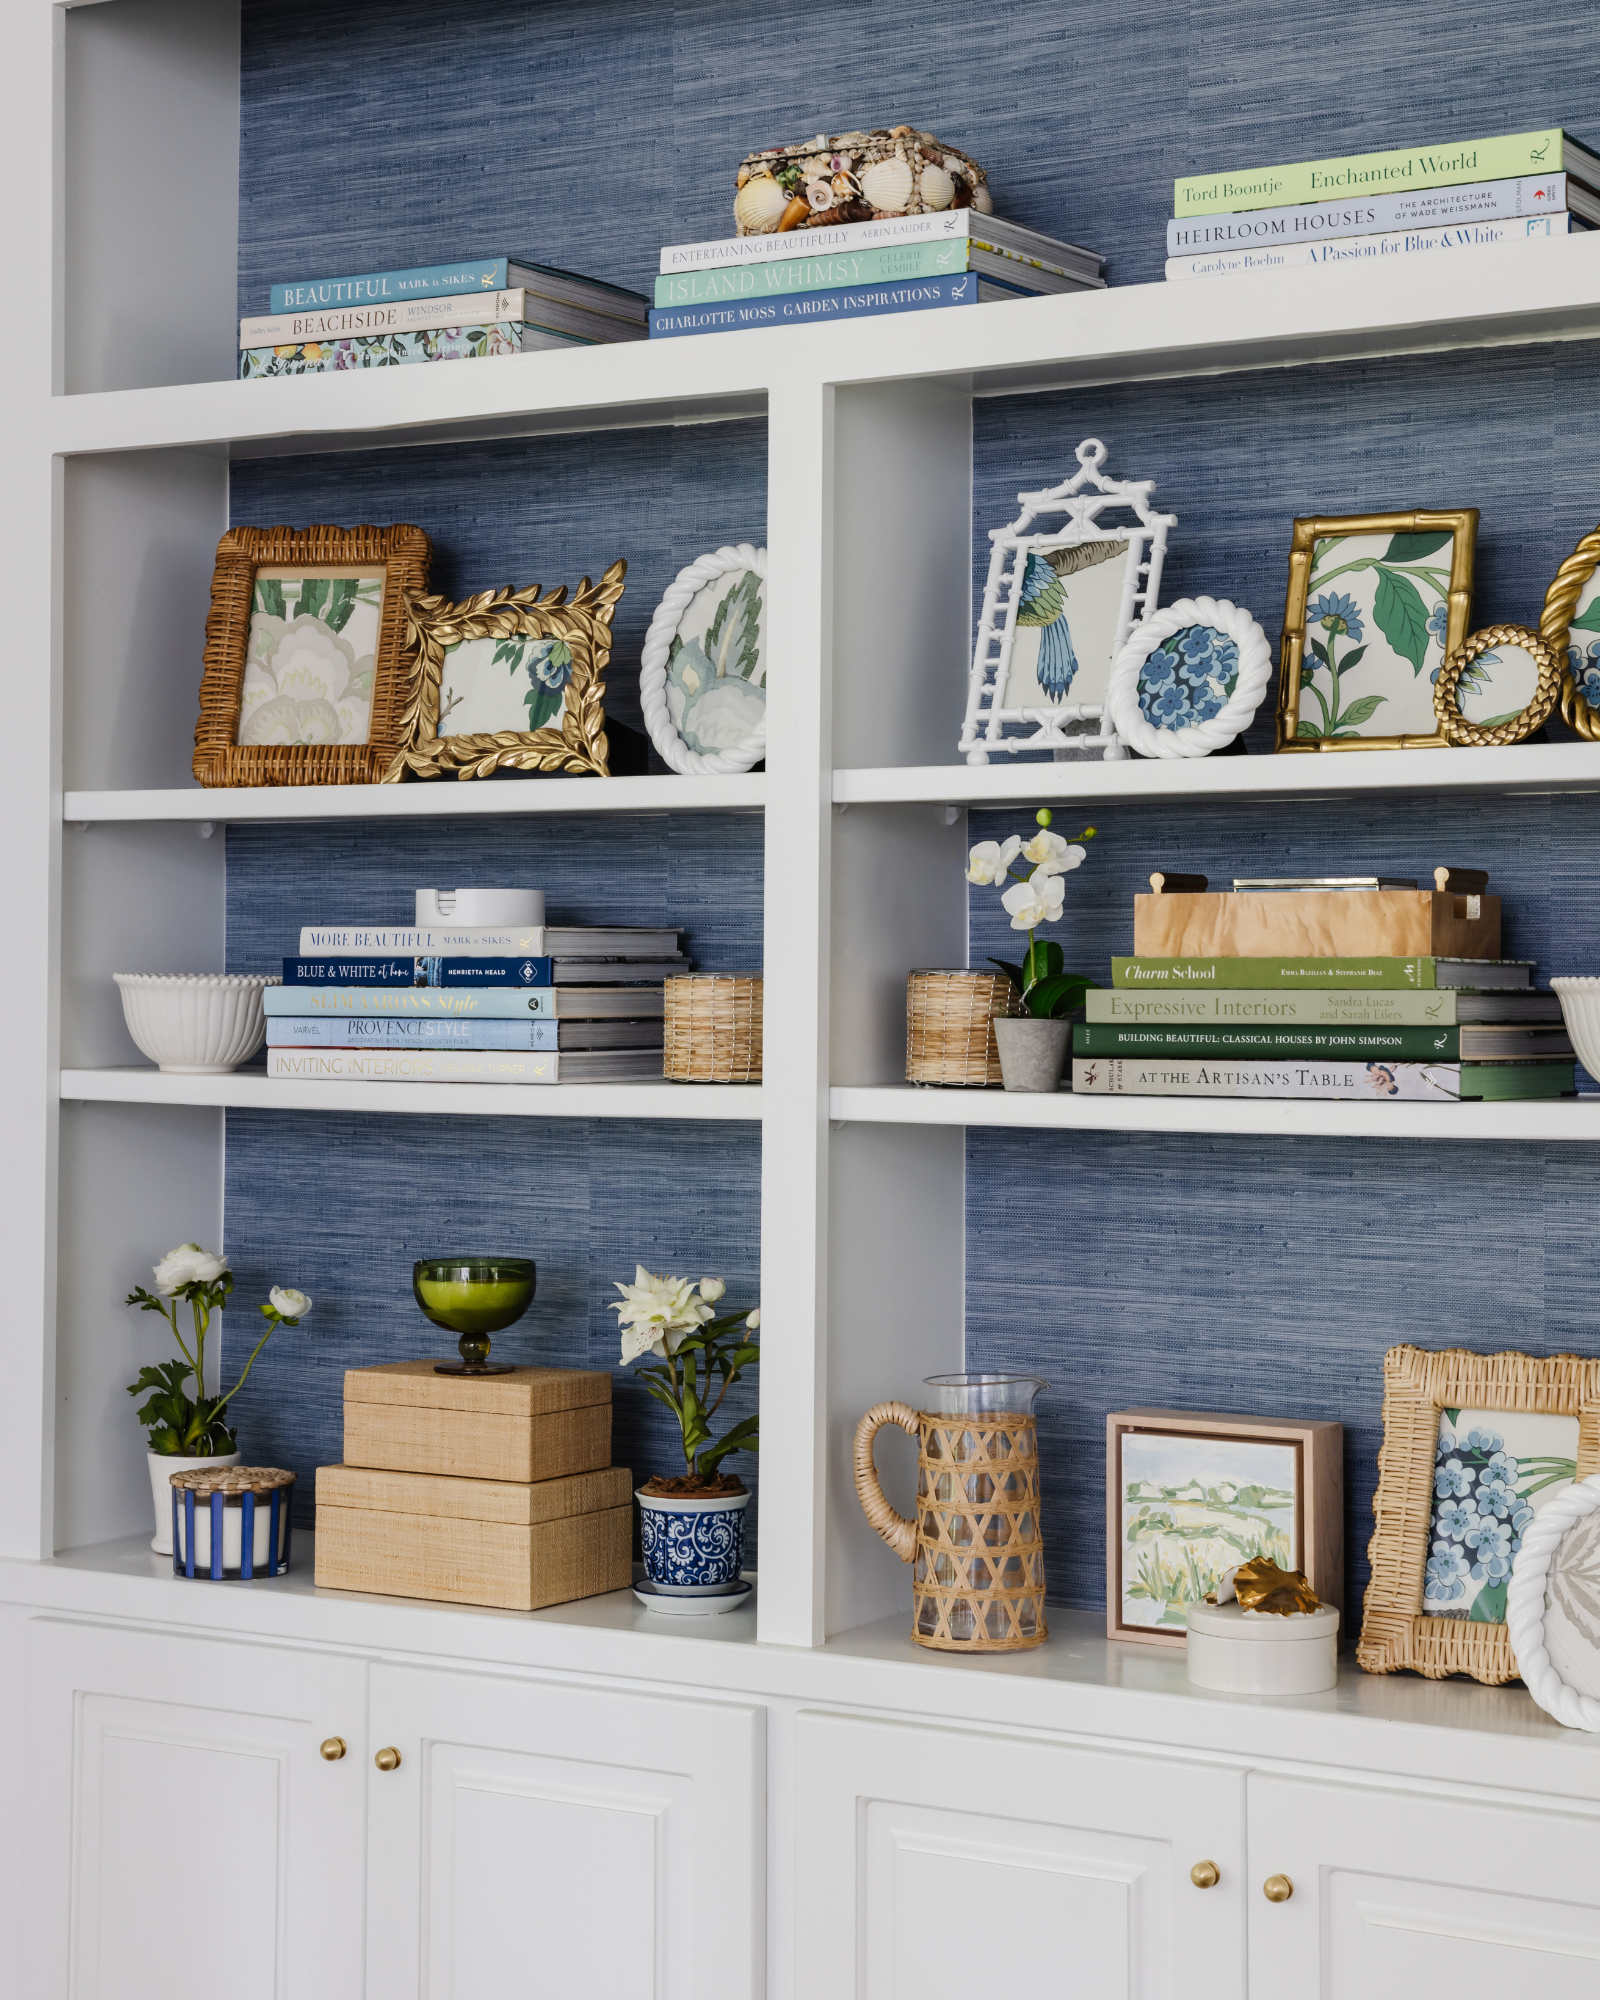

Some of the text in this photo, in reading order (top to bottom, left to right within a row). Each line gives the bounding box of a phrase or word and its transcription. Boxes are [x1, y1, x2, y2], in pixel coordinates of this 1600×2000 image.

[1310, 151, 1478, 189] Enchanted World
[1183, 178, 1283, 203] Tord Boontje
[1399, 192, 1493, 210] THE ARCHITECTURE
[1395, 201, 1497, 220] OF WADE WEISSMANN
[860, 222, 932, 239] AERIN LAUDER
[1176, 208, 1375, 246] HEIRLOOM HOUSES
[672, 231, 849, 264] ENTERTAINING BEAUTIFULLY
[1305, 226, 1504, 264] A Passion for Blue & White
[879, 250, 924, 263] CELERIE
[1192, 253, 1285, 275] Carolyne Roehm
[880, 262, 922, 275] KEMBLE
[669, 257, 864, 301] ISLAND WHIMSY
[283, 278, 391, 307] BEAUTIFUL
[398, 279, 430, 291] MARK
[441, 273, 475, 286] SIKES
[407, 303, 452, 316] WINDSOR
[656, 286, 941, 331] CHARLOTTE MOSS GARDEN INSPIRATIONS
[292, 309, 397, 335] BEACHSIDE
[406, 314, 445, 323] ARCHITECTURE
[426, 343, 471, 355] Interiors
[254, 350, 331, 373] de Gournay
[309, 932, 350, 947] MORE
[354, 932, 435, 947] BEAUTIFUL
[443, 936, 471, 945] MARK
[481, 936, 511, 945] SIKES
[297, 961, 410, 979] BLUE & WHITE at home
[1125, 965, 1216, 980] Charm School
[310, 993, 478, 1015] SLIM AARONS Style
[1110, 996, 1297, 1021] Expressive Interiors
[1327, 996, 1395, 1008] Sandra Lucas
[1319, 1008, 1403, 1020] and Sarah Eilers
[293, 1026, 321, 1035] VARVEL
[1118, 1033, 1403, 1046] BUILDING BEAUTIFUL: CLASSICAL HOUSES BY JOHN SIMPSON
[276, 1057, 526, 1075] INVITING INTERIORS MELANIE TURNER
[1138, 1072, 1158, 1083] AT
[1160, 1072, 1191, 1084] THE
[1295, 1069, 1354, 1087] TABLE
